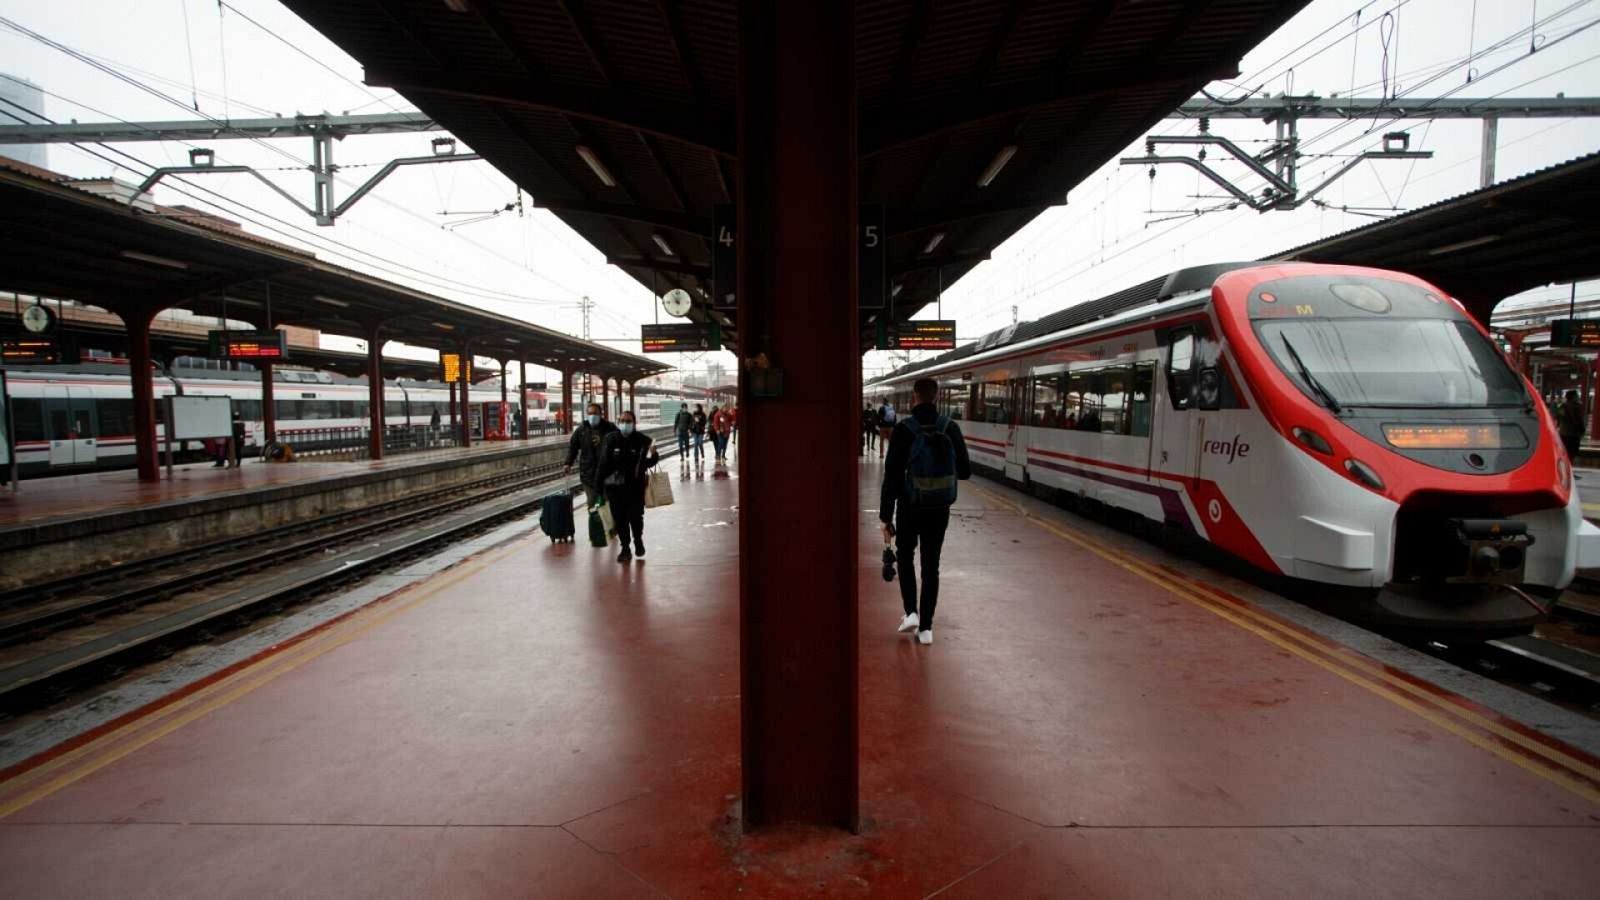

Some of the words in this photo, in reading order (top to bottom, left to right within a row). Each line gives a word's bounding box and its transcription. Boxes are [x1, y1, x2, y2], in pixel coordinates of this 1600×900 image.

[719, 224, 734, 248] 4
[865, 224, 879, 248] 5
[701, 337, 709, 349] 4
[887, 336, 895, 347] 5
[1204, 434, 1250, 464] renfe
